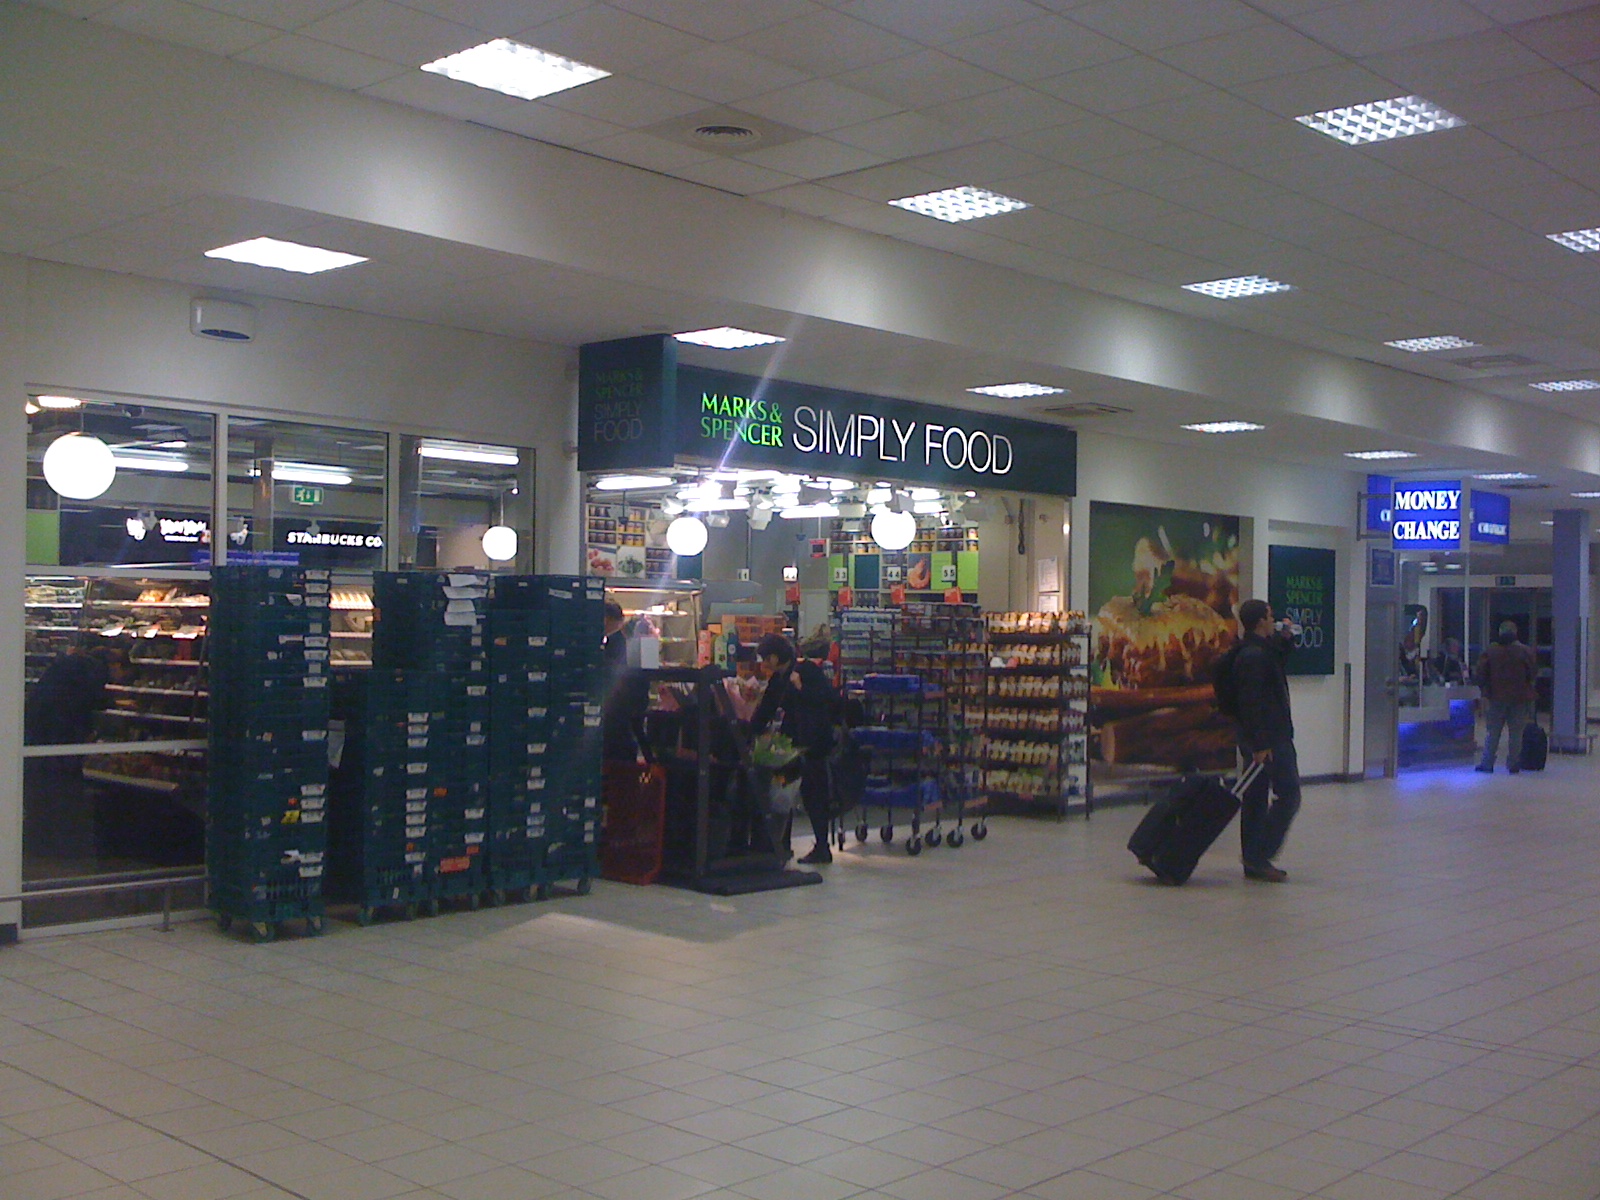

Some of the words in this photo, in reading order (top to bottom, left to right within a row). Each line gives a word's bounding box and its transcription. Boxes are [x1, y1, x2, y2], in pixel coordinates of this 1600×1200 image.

[701, 392, 766, 423] MARKS
[769, 402, 782, 423] &
[594, 419, 642, 441] FOOD
[701, 416, 783, 447] SPENCER
[792, 406, 916, 462] SIMPLY
[925, 424, 1013, 475] FOOD
[1394, 490, 1461, 510] MONEY
[287, 532, 364, 546] STARBUCKS
[365, 535, 384, 547] CO
[1393, 521, 1460, 540] CHANGE
[1293, 626, 1323, 648] OOD
